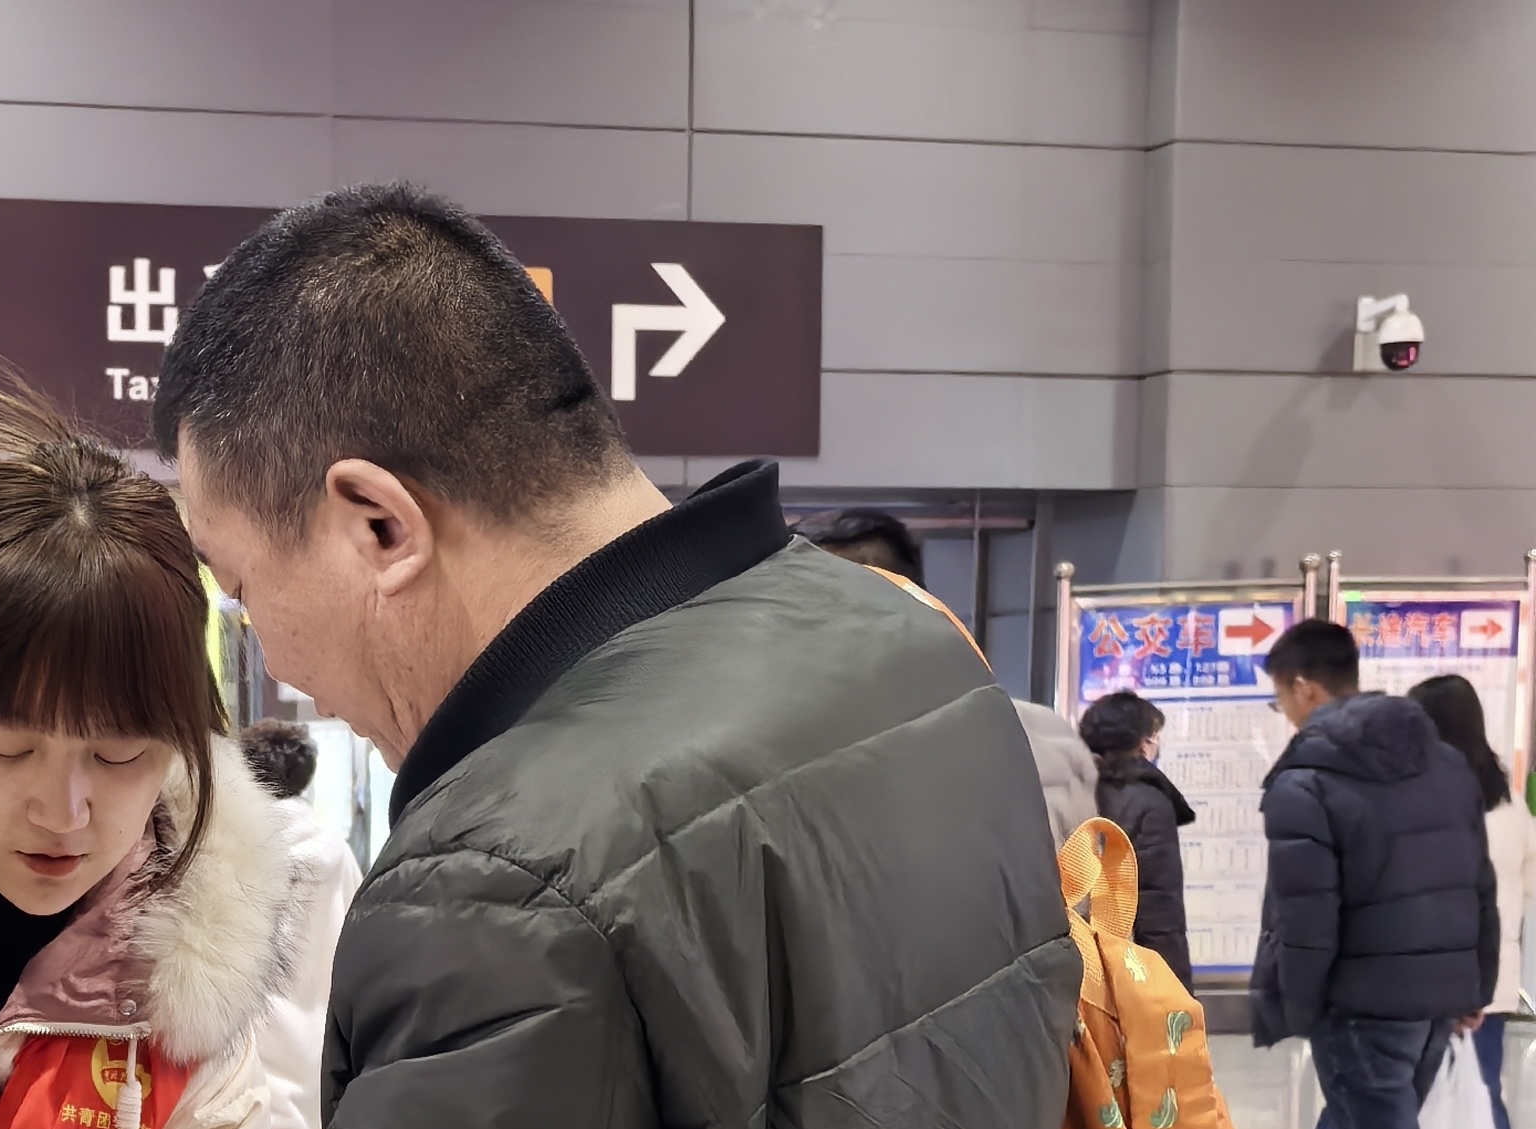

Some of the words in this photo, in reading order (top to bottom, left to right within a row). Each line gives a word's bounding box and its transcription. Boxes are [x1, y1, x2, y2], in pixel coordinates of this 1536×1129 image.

[107, 257, 227, 347] 出
[1088, 614, 1217, 660] 公交车
